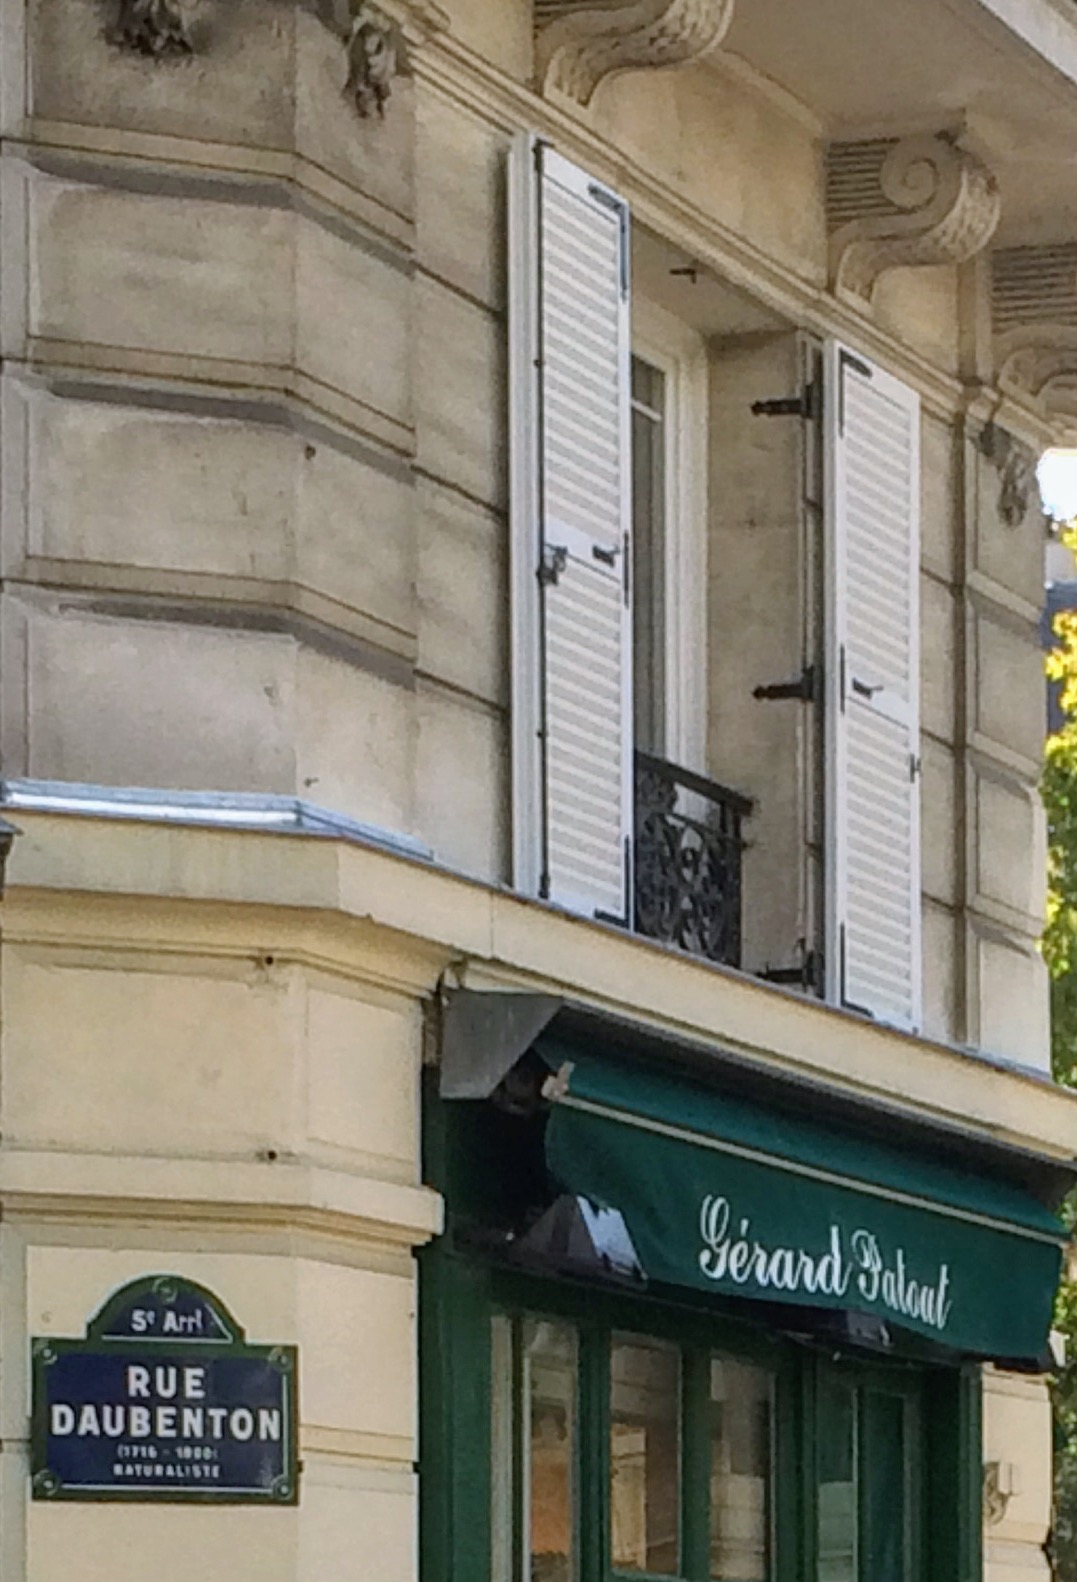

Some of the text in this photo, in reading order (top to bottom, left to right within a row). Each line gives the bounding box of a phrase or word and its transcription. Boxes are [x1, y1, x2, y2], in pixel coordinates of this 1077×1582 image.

[698, 1194, 853, 1296] Gérard
[127, 1365, 207, 1399] RUE
[50, 1403, 281, 1441] DAUBENTON
[113, 1463, 220, 1479] NATURALISTE
